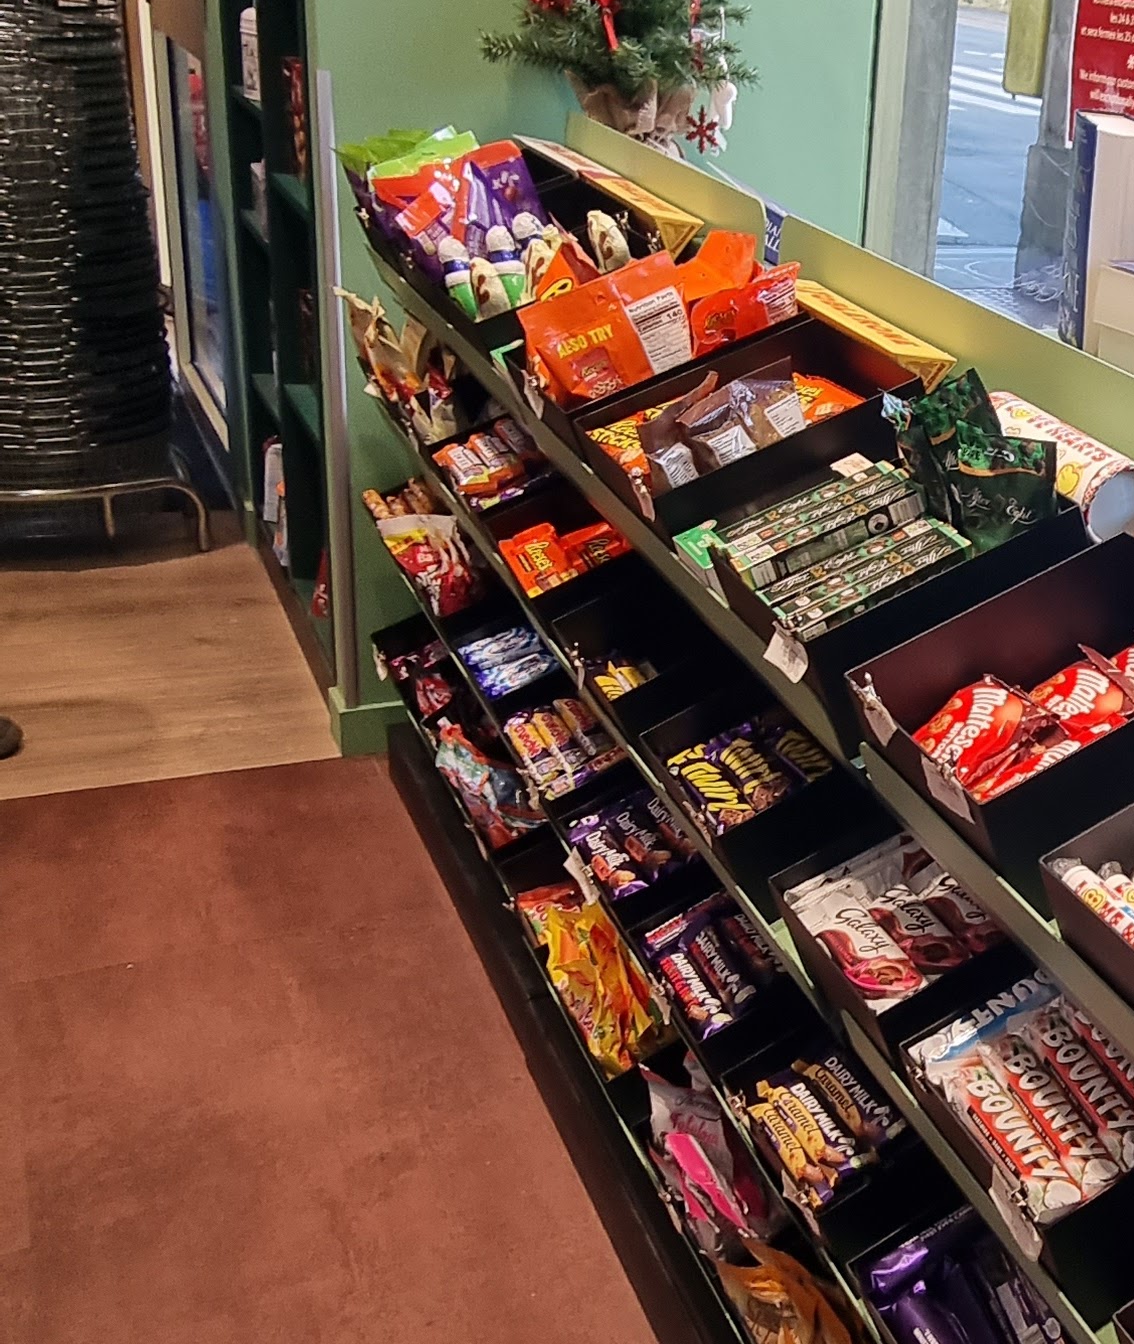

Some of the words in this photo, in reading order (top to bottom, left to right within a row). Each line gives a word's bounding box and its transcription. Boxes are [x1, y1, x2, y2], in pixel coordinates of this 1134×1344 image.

[557, 334, 588, 359] ALSO
[588, 323, 613, 345] TRY
[834, 907, 892, 955] Galaxy
[883, 885, 937, 933] Galaxy
[669, 950, 699, 981] DAIRY
[686, 975, 713, 1003] MILK
[779, 1086, 818, 1136] Caramel
[824, 1056, 857, 1093] DAIRY
[849, 1084, 878, 1117] MILK
[1003, 1052, 1106, 1157] BOUNTY
[763, 1105, 801, 1155] Caramel
[790, 1081, 822, 1117] DAIRY
[816, 1110, 845, 1144] MILK
[967, 1078, 1071, 1180] BOUNTY
